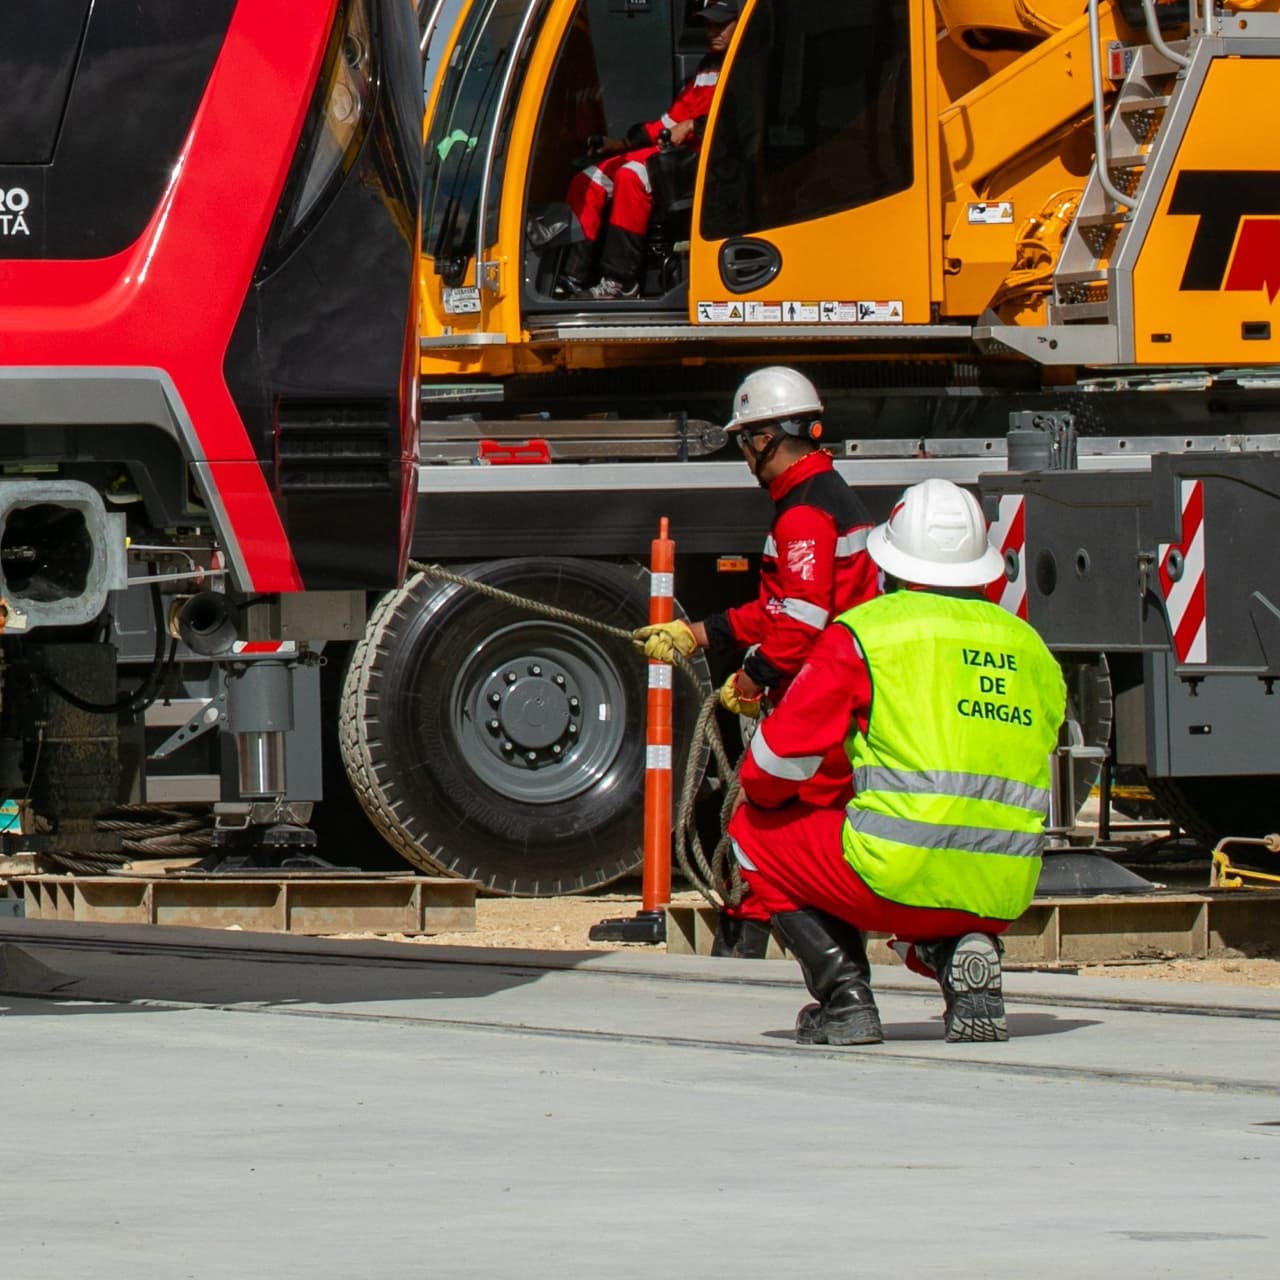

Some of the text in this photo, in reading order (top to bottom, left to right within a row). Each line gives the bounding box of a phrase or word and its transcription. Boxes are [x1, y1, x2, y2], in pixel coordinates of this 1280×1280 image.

[962, 648, 1017, 672] IZAJE
[979, 675, 1006, 696] DE
[957, 698, 1033, 727] CARGAS
